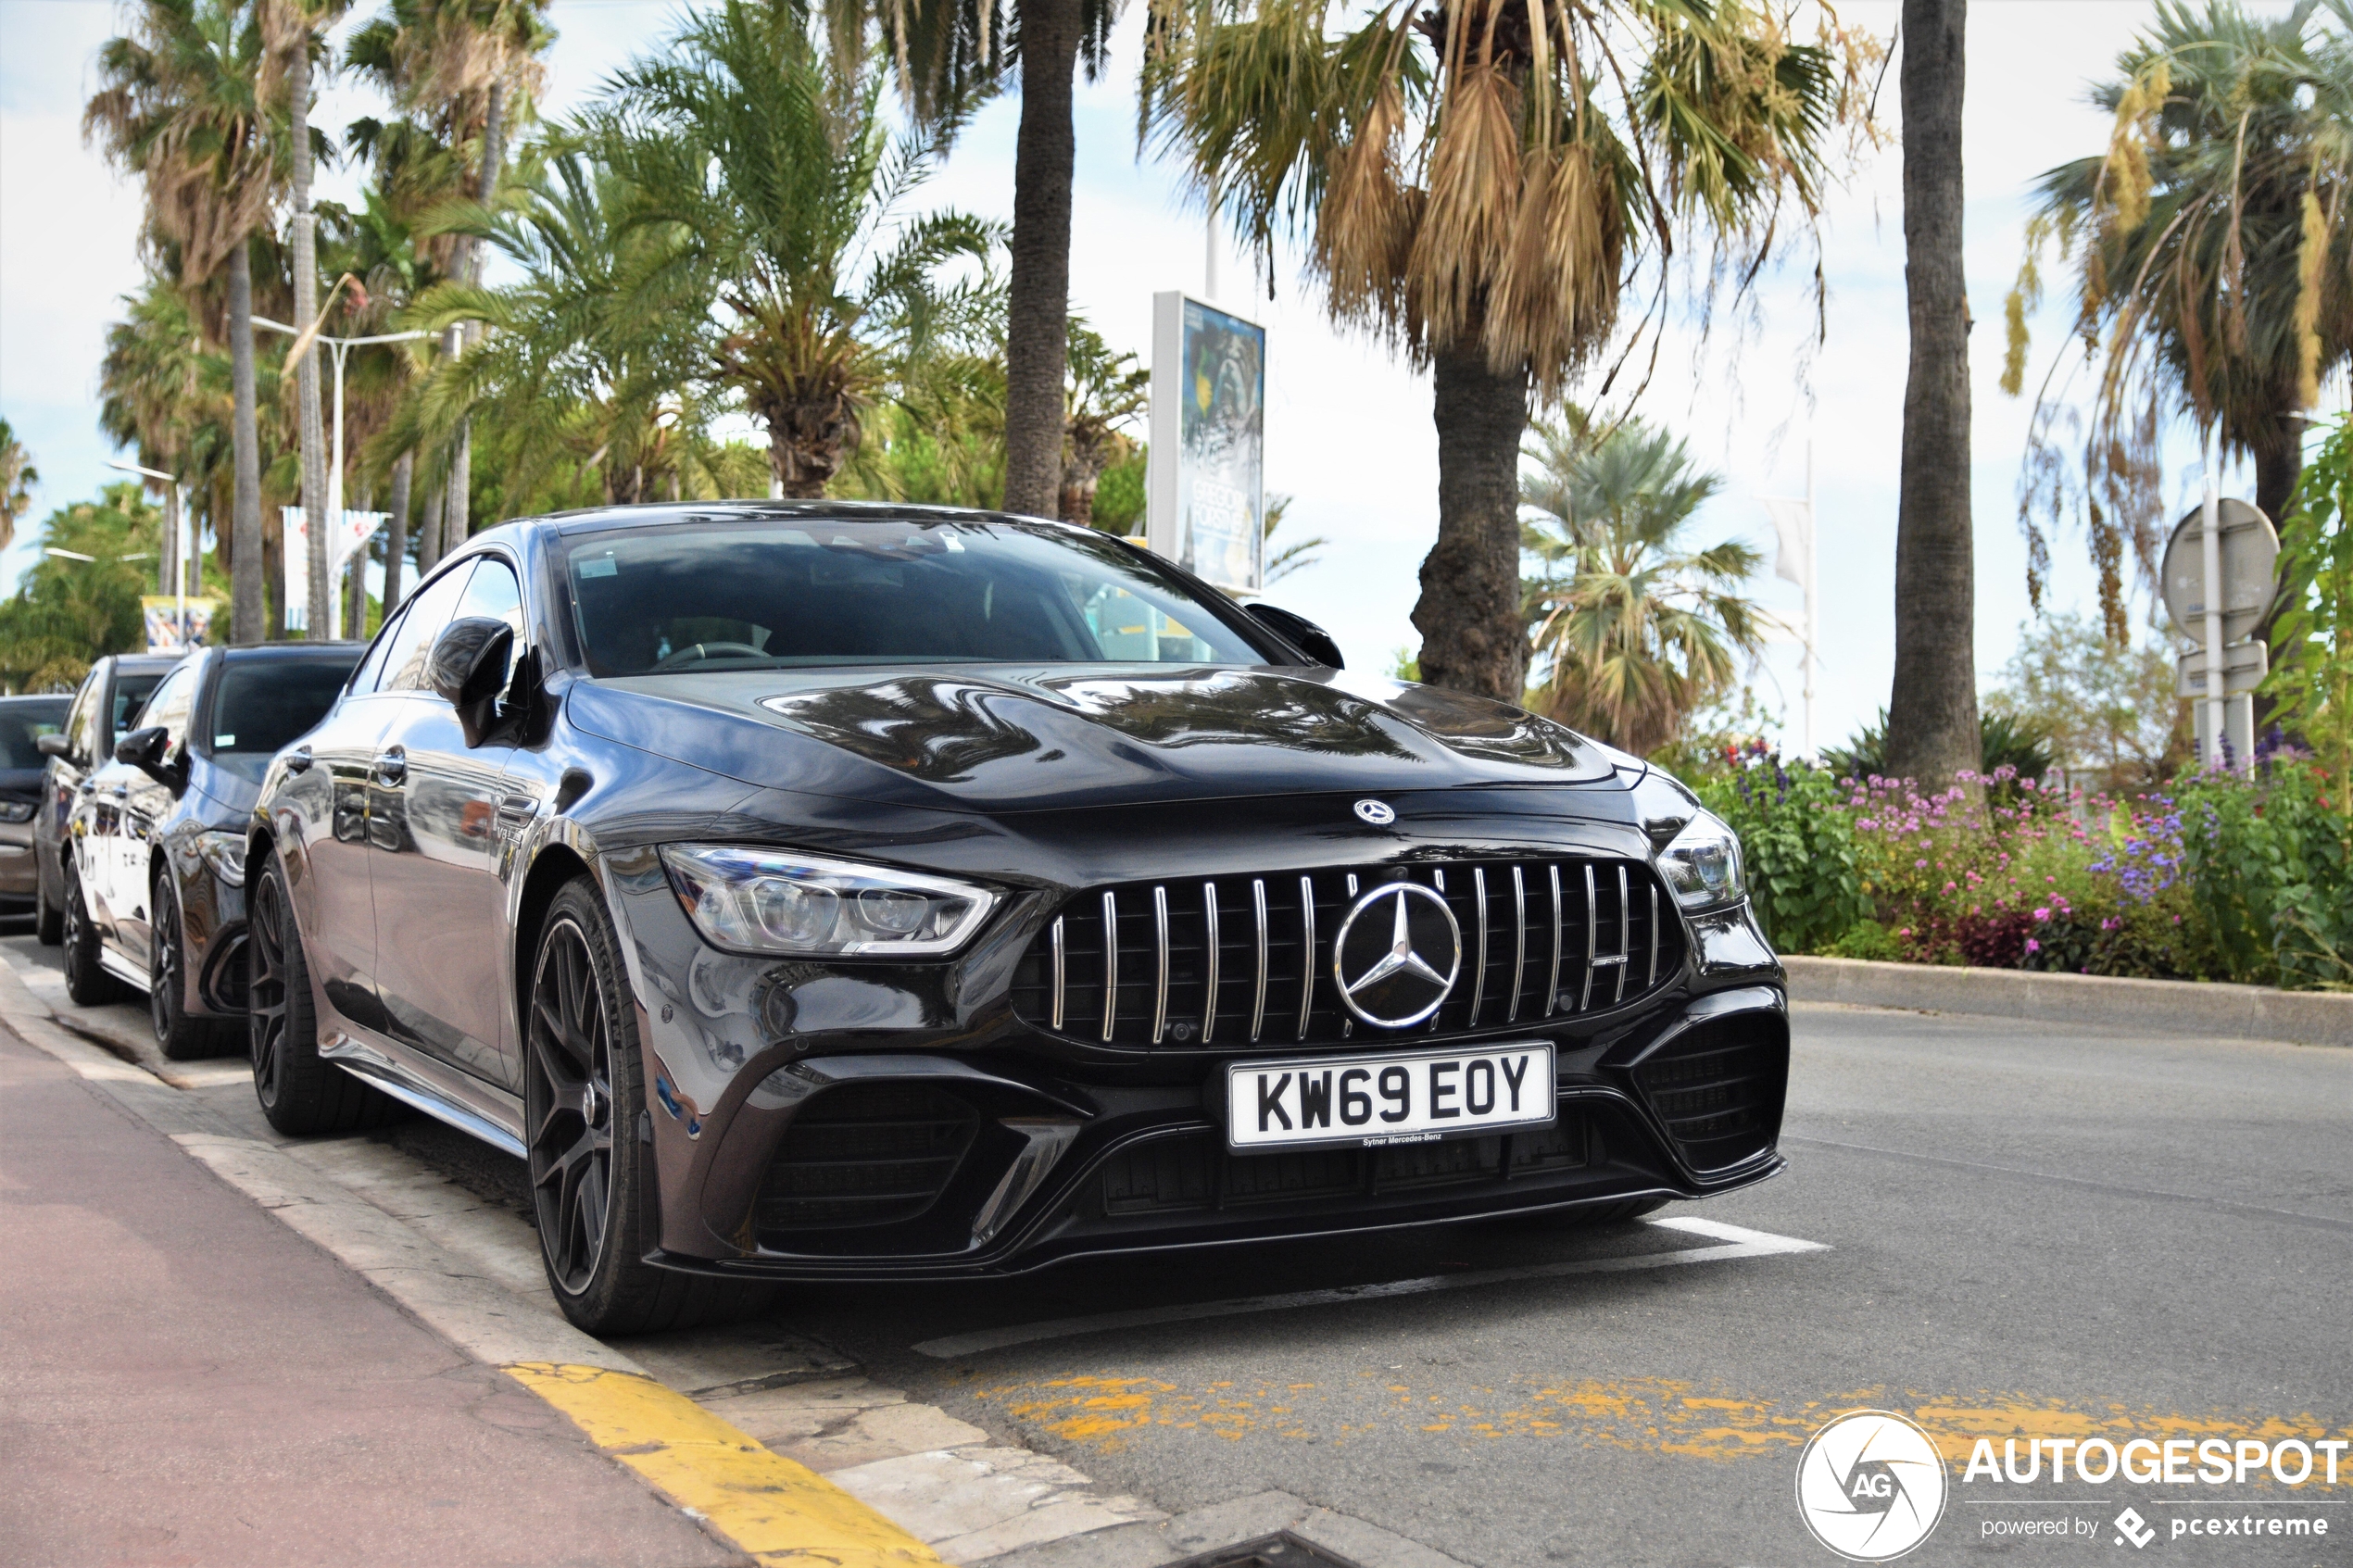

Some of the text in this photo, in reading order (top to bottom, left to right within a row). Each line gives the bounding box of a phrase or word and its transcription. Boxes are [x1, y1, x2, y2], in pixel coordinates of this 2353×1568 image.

[593, 934, 622, 1039] MICHELIN
[1257, 1055, 1529, 1133] KW69 EOY
[1363, 1133, 1442, 1148] Sytner Mercedes-Benz
